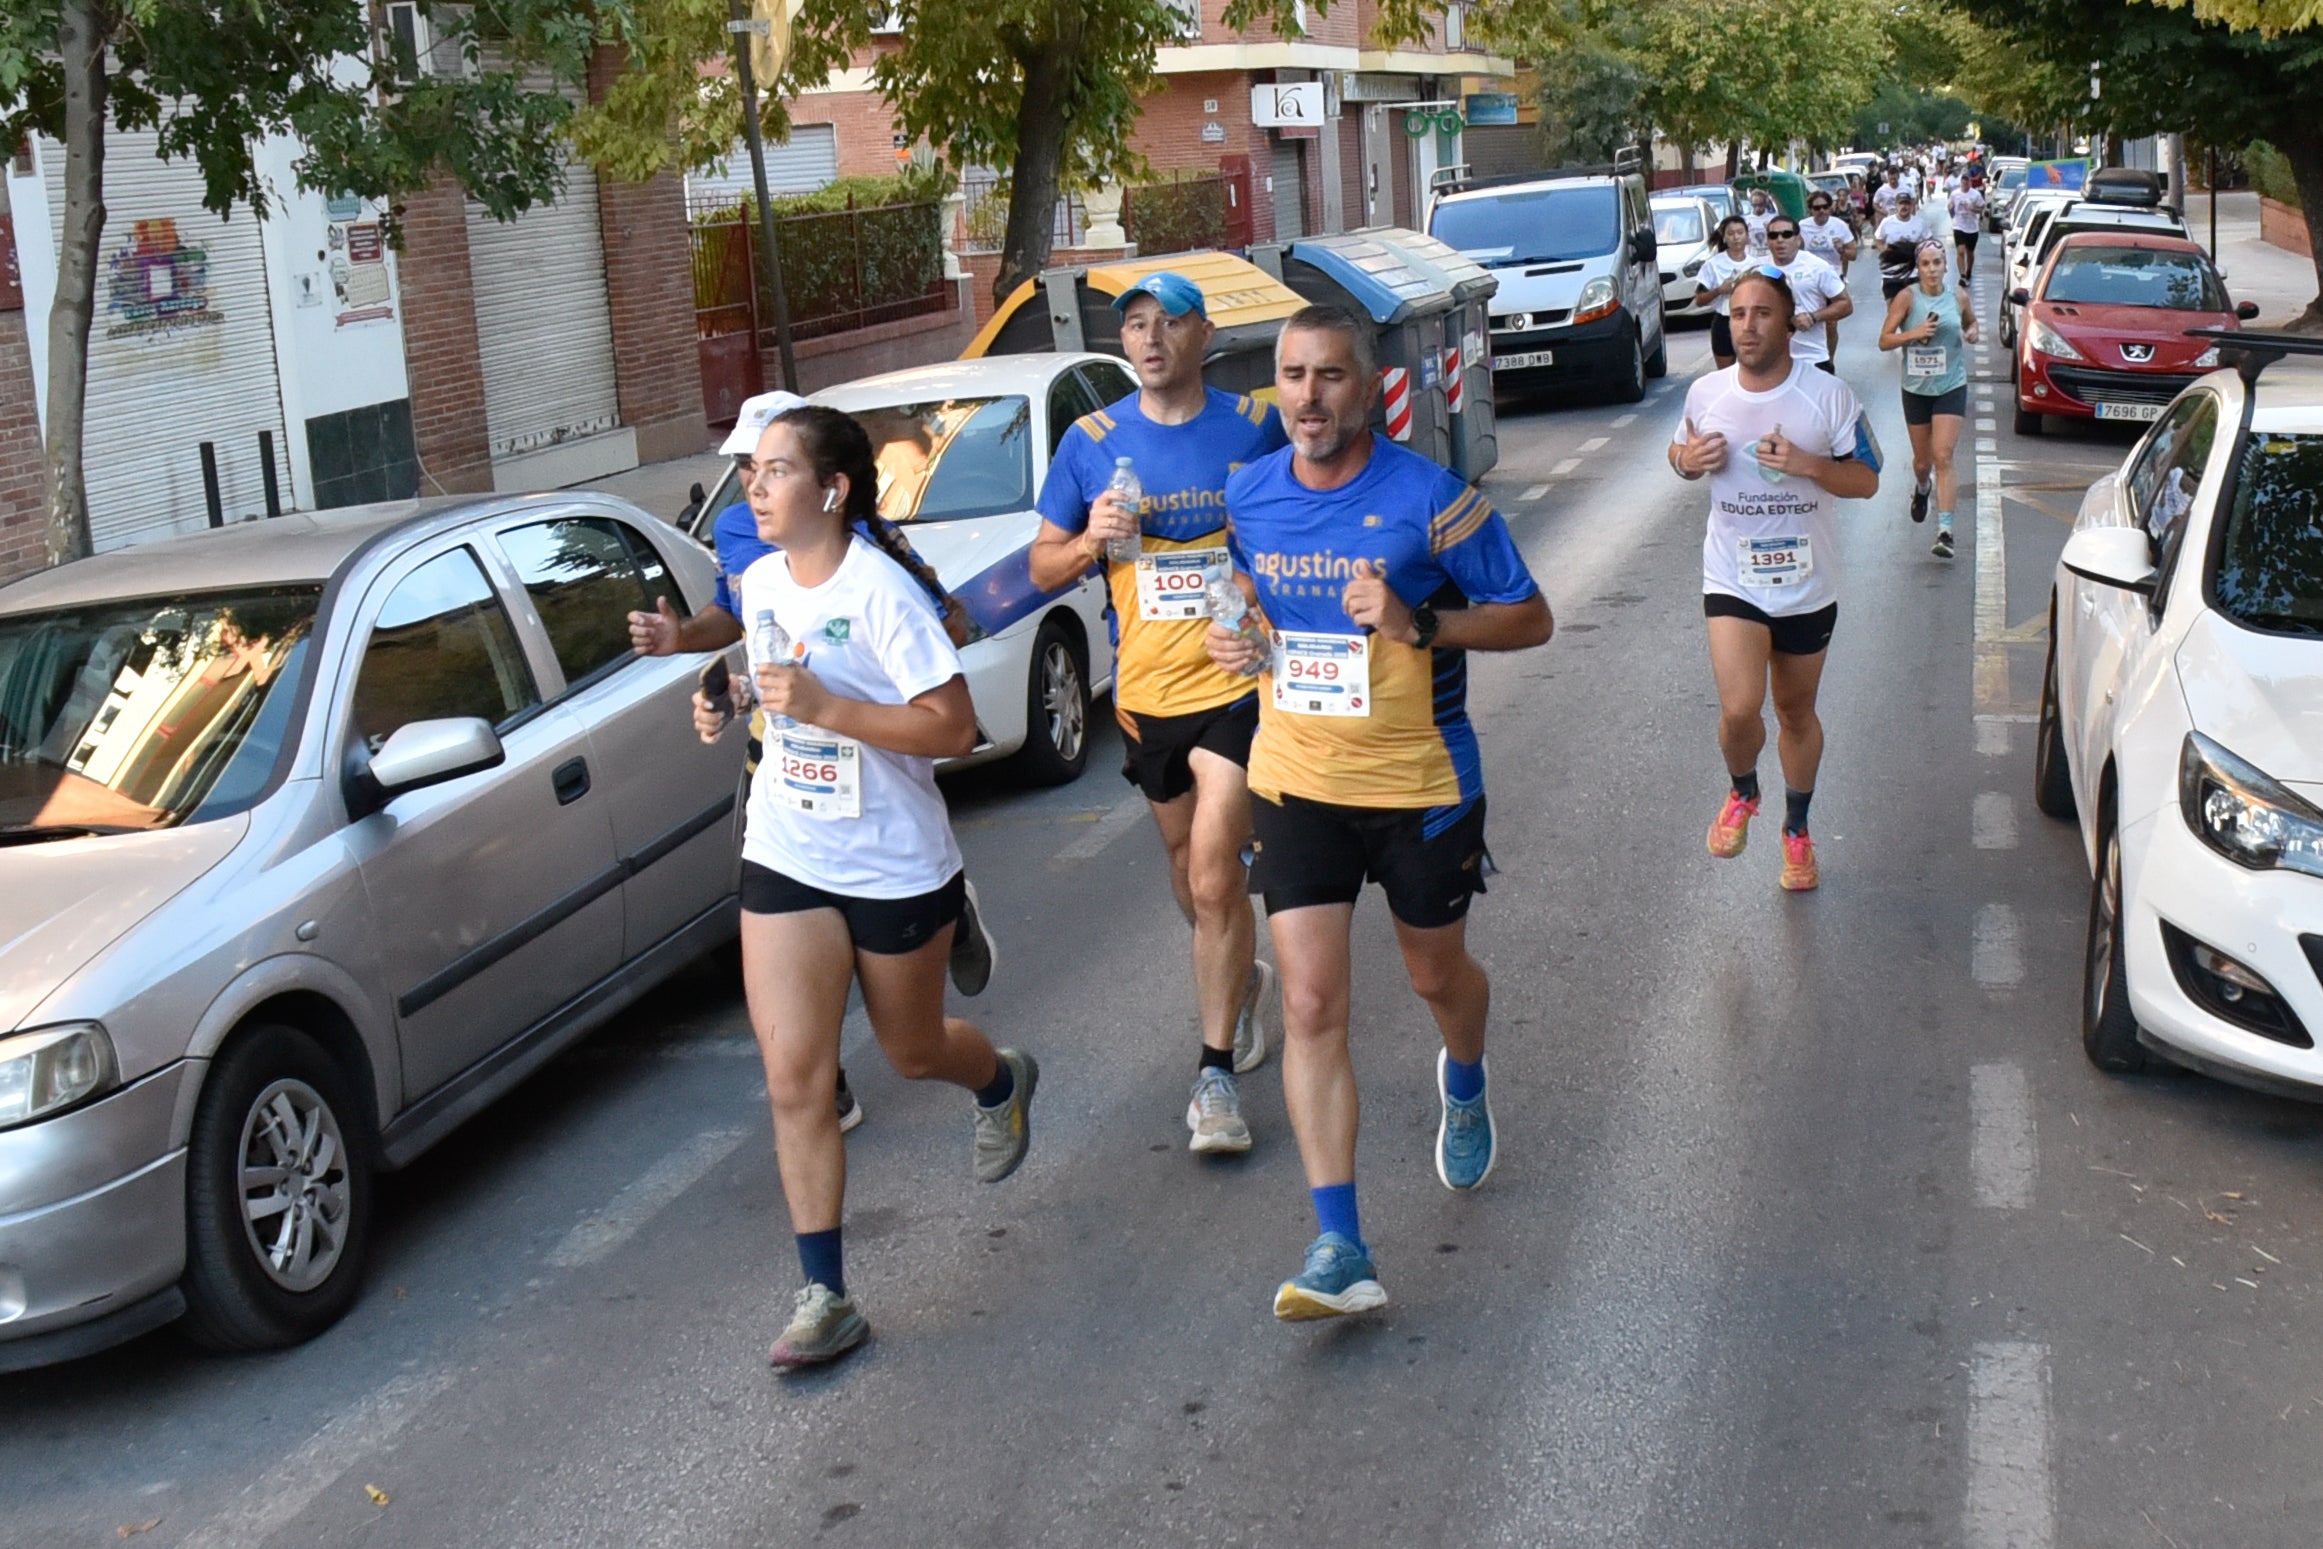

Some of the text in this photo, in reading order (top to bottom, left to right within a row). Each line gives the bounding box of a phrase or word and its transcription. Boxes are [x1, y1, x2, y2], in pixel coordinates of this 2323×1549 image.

[1496, 356, 1524, 369] 7388
[2105, 406, 2158, 419] 7696 GP
[1139, 486, 1226, 518] gustino
[1738, 491, 1799, 503] Fundación
[1721, 500, 1819, 516] EDUCA EDTECH
[1751, 551, 1797, 565] 1391
[1255, 549, 1388, 587] agustinos
[1289, 659, 1339, 681] 949
[782, 756, 837, 782] 1266
